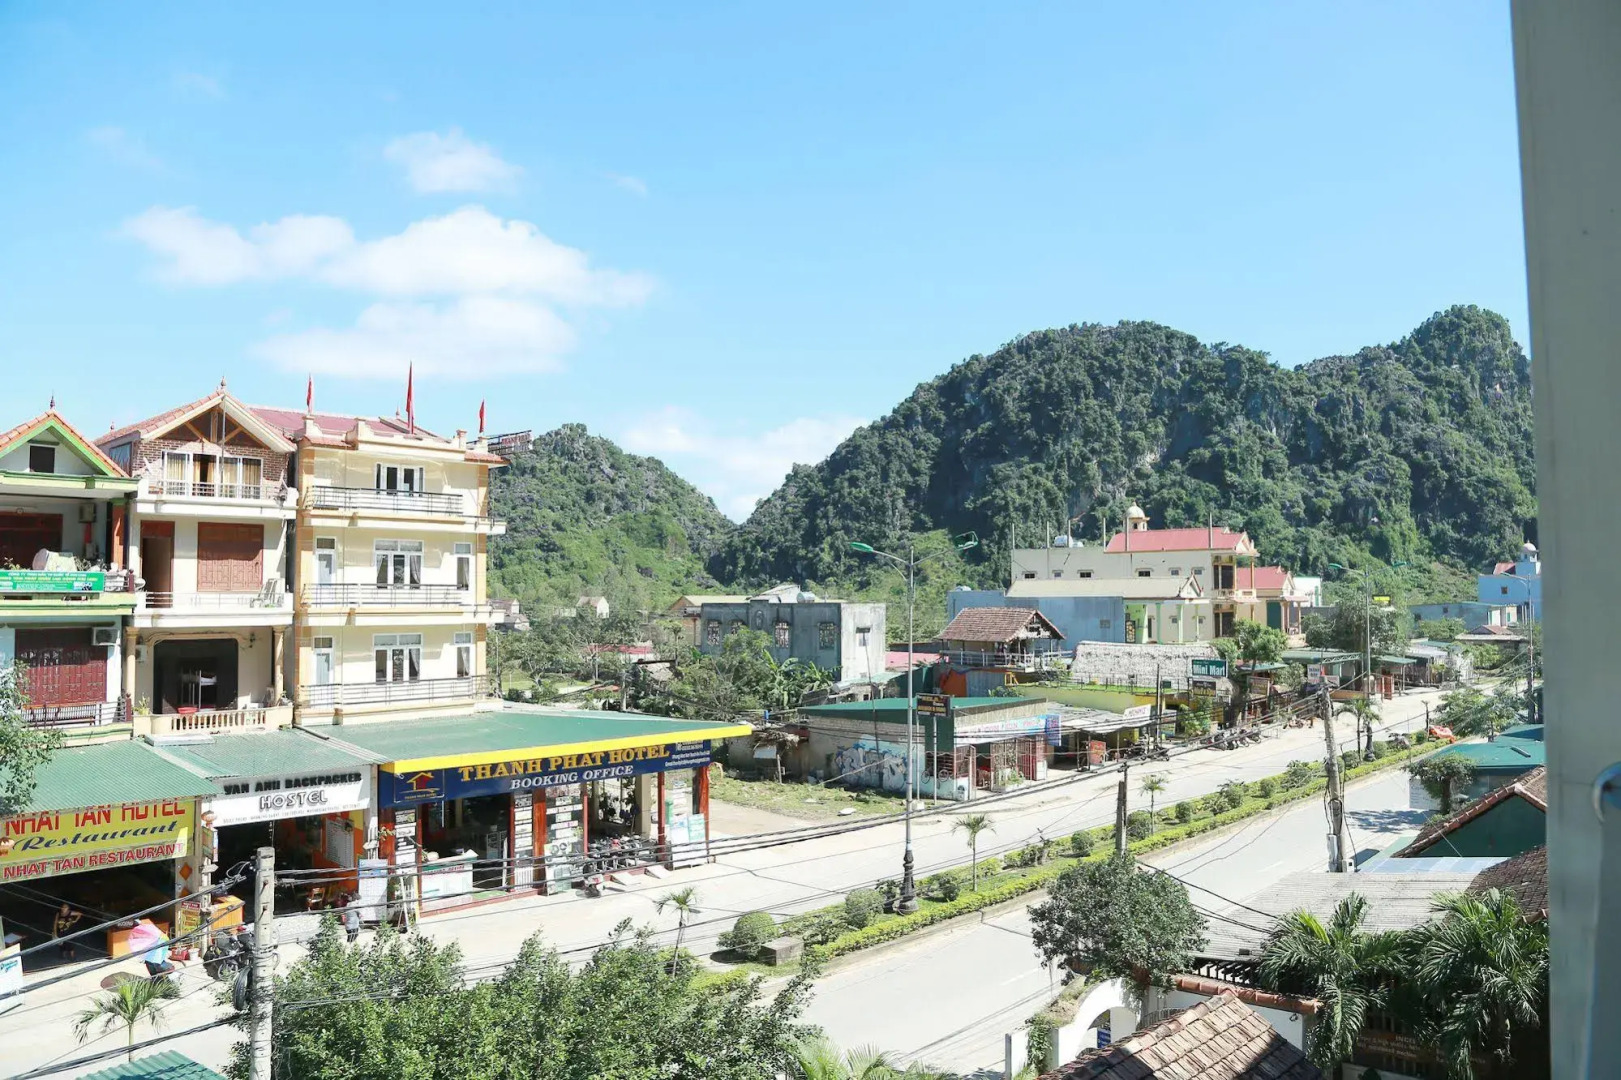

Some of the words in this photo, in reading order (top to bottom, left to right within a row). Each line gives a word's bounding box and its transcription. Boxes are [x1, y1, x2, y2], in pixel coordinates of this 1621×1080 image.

[1209, 665, 1225, 676] Mart
[458, 758, 543, 782] THANH
[548, 751, 606, 771] PHAT
[608, 744, 670, 765] HOTEL
[285, 772, 362, 789] BACKPACKER
[510, 771, 578, 790] BOOKING
[582, 764, 634, 781] OFFICE
[259, 790, 328, 811] HOSTEL
[12, 820, 178, 851] Restaurant
[3, 861, 48, 879] NHAT
[53, 856, 85, 873] TAN
[89, 842, 183, 866] RESTAURANT
